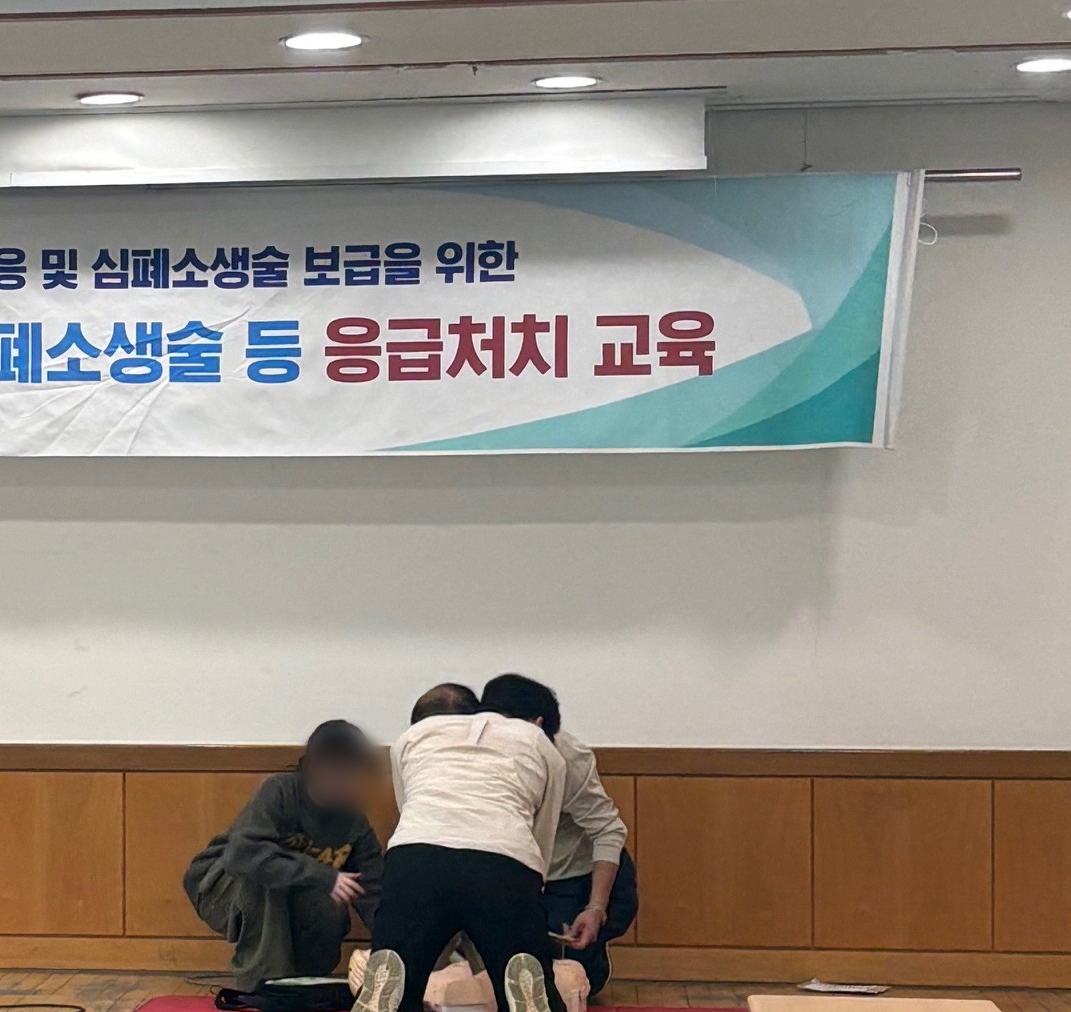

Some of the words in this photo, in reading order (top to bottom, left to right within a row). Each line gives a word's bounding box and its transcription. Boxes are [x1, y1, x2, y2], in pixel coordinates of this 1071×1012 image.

[42, 248, 77, 289] 및
[92, 246, 290, 289] 심폐소생술
[304, 242, 422, 286] 보급을
[436, 240, 519, 284] 위한
[245, 320, 302, 384] 등
[325, 314, 569, 383] 응급처치
[594, 310, 716, 376] 교육
